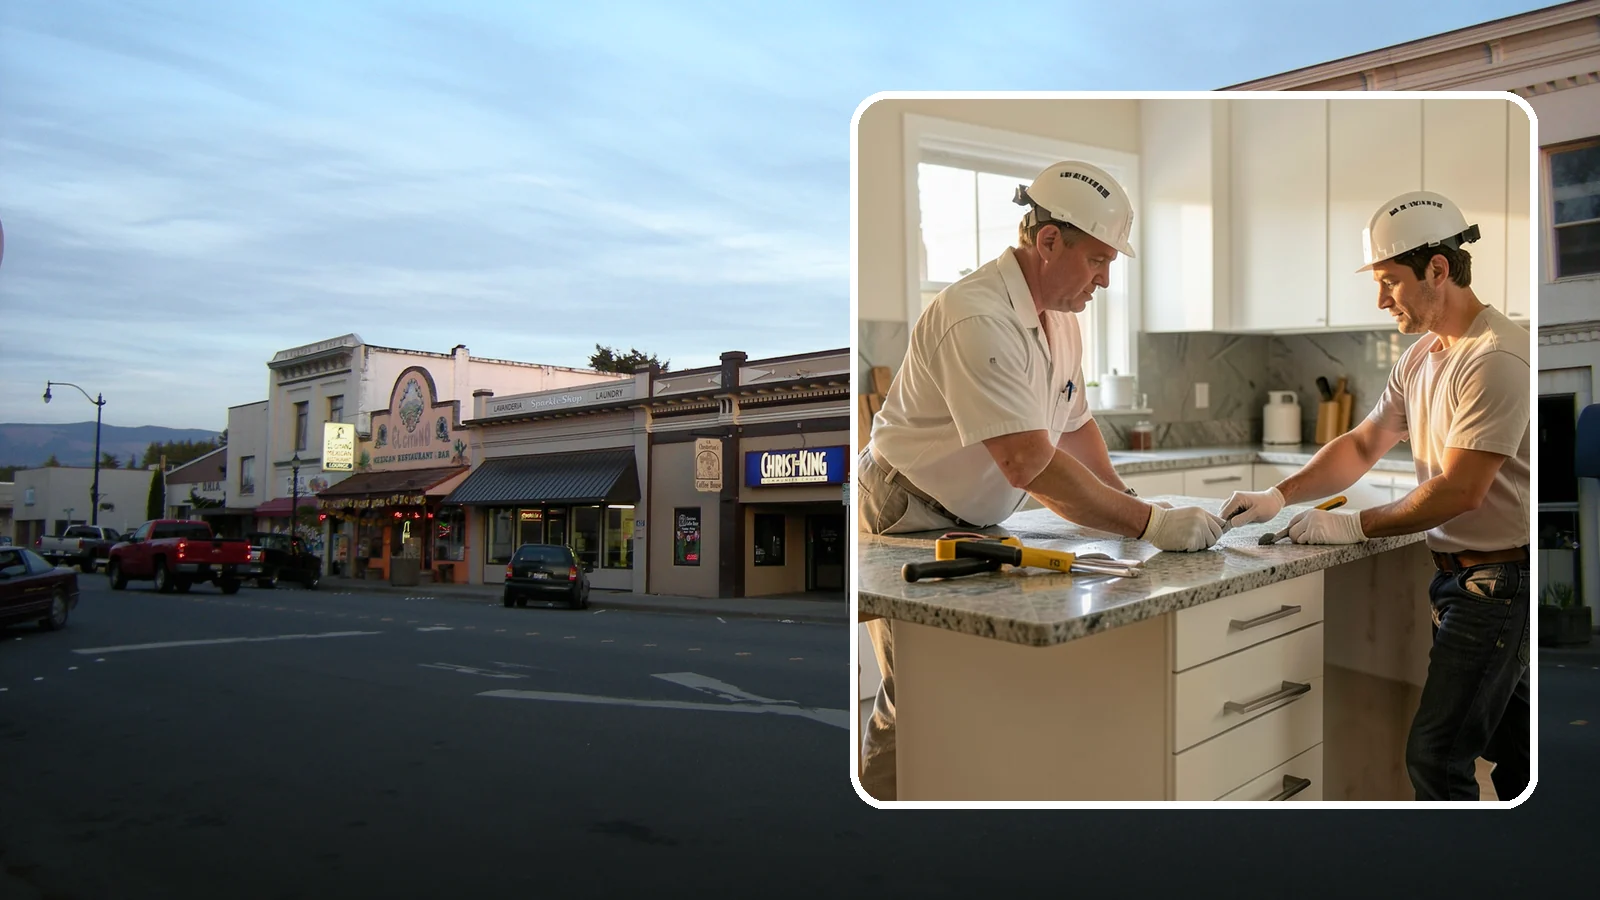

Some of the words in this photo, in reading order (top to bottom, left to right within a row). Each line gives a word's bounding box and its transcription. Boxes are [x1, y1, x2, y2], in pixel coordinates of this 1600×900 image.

[493, 402, 522, 412] LAVANDERIA
[530, 397, 559, 409] Sparkle
[562, 394, 582, 405] Shop
[595, 389, 623, 400] LAUNDRY
[397, 452, 433, 462] RESTAURANT
[438, 450, 450, 459] BAR
[697, 481, 709, 489] Coffee
[710, 481, 721, 489] House
